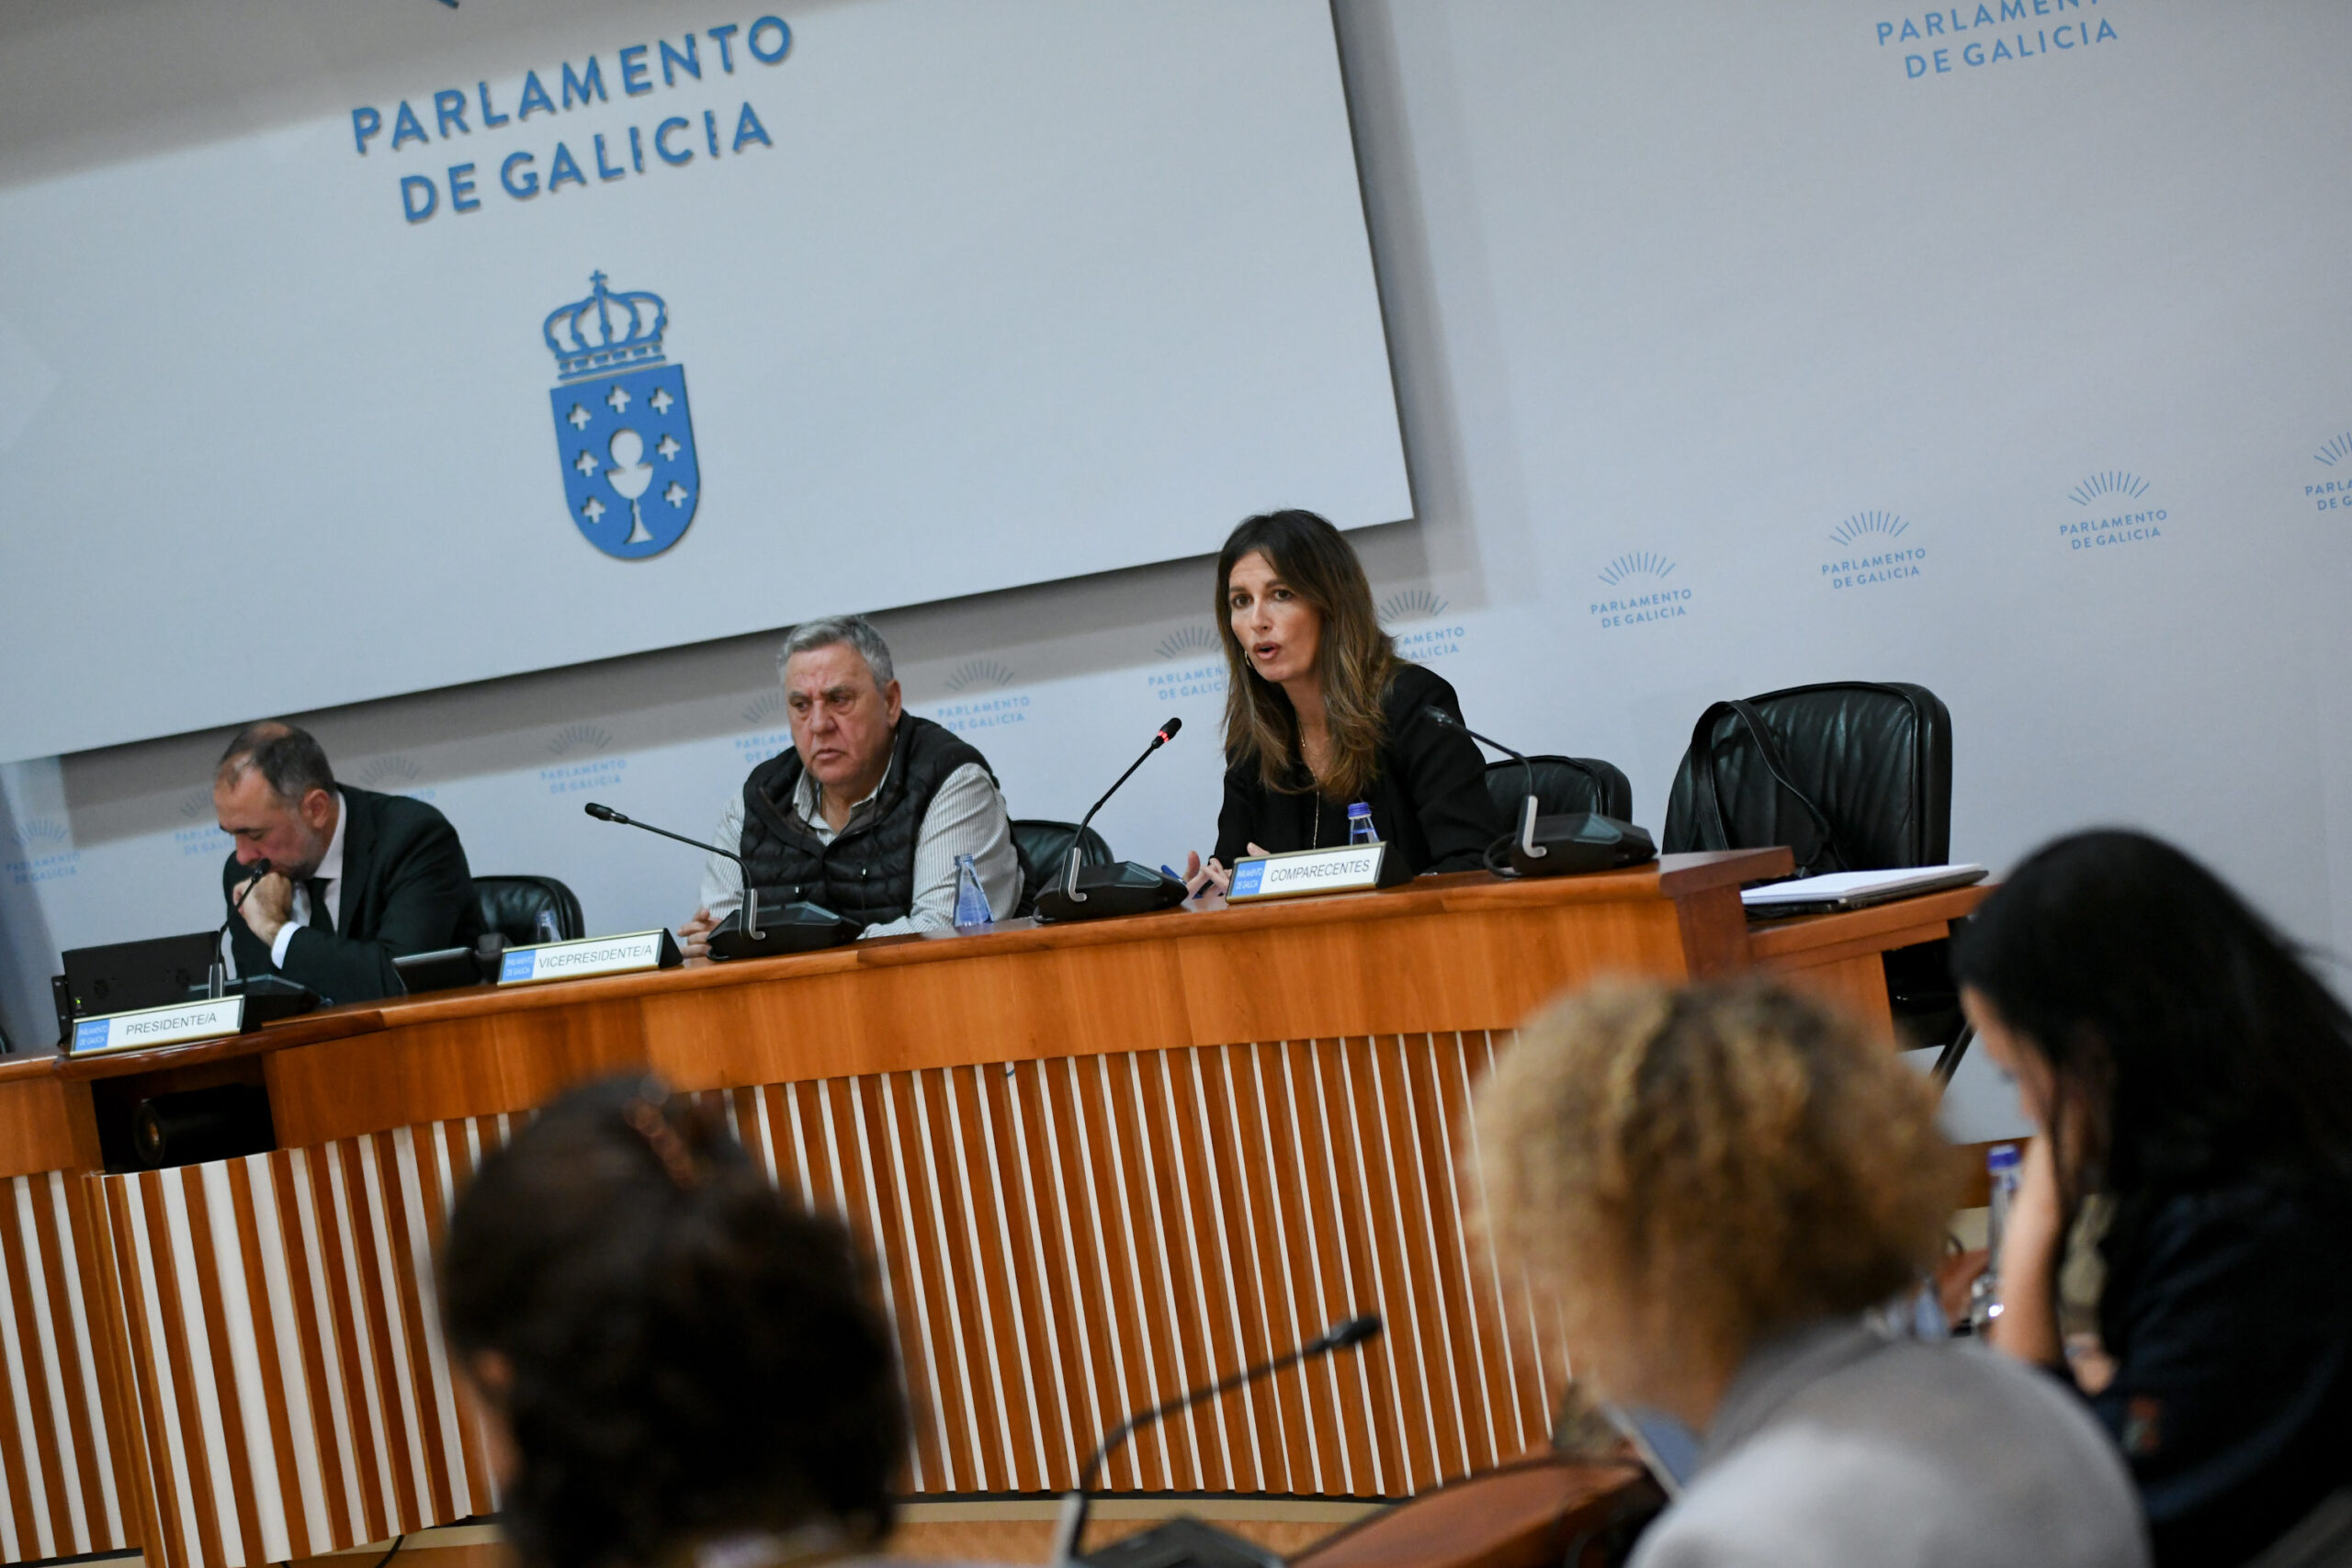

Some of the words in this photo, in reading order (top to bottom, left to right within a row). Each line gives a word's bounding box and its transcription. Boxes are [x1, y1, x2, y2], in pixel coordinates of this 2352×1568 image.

[1876, 0, 2098, 46] PARLAME
[1905, 49, 1951, 79] DE
[1962, 18, 2118, 66] GALICIA
[352, 16, 792, 154] PARLAMENTO
[401, 163, 481, 223] DE
[501, 102, 773, 199] GALICIA
[2317, 498, 2338, 511] DE
[2060, 510, 2167, 536] PARLAMENTO
[2072, 537, 2091, 550] DE
[2096, 526, 2161, 546] GALICIA
[1822, 548, 1926, 575] PARLAMENTO
[1833, 577, 1852, 589] DE
[1857, 566, 1919, 585] GALICIA
[1590, 589, 1691, 615] PARLAMENTO
[1602, 616, 1621, 628] DE
[1624, 606, 1686, 624] GALICIA
[1400, 626, 1464, 647] AMENTO
[1148, 667, 1224, 686] PARLAMEN
[1159, 689, 1176, 700] DE
[1181, 682, 1222, 696] GALIC
[938, 696, 1029, 717] PARLAMENTO
[969, 714, 1024, 728] GALICIA
[1271, 860, 1370, 882] COMPARECENTES
[538, 944, 652, 968] VICEPRESIDENTE/A
[126, 1012, 217, 1035] PRESIDENTE/A
